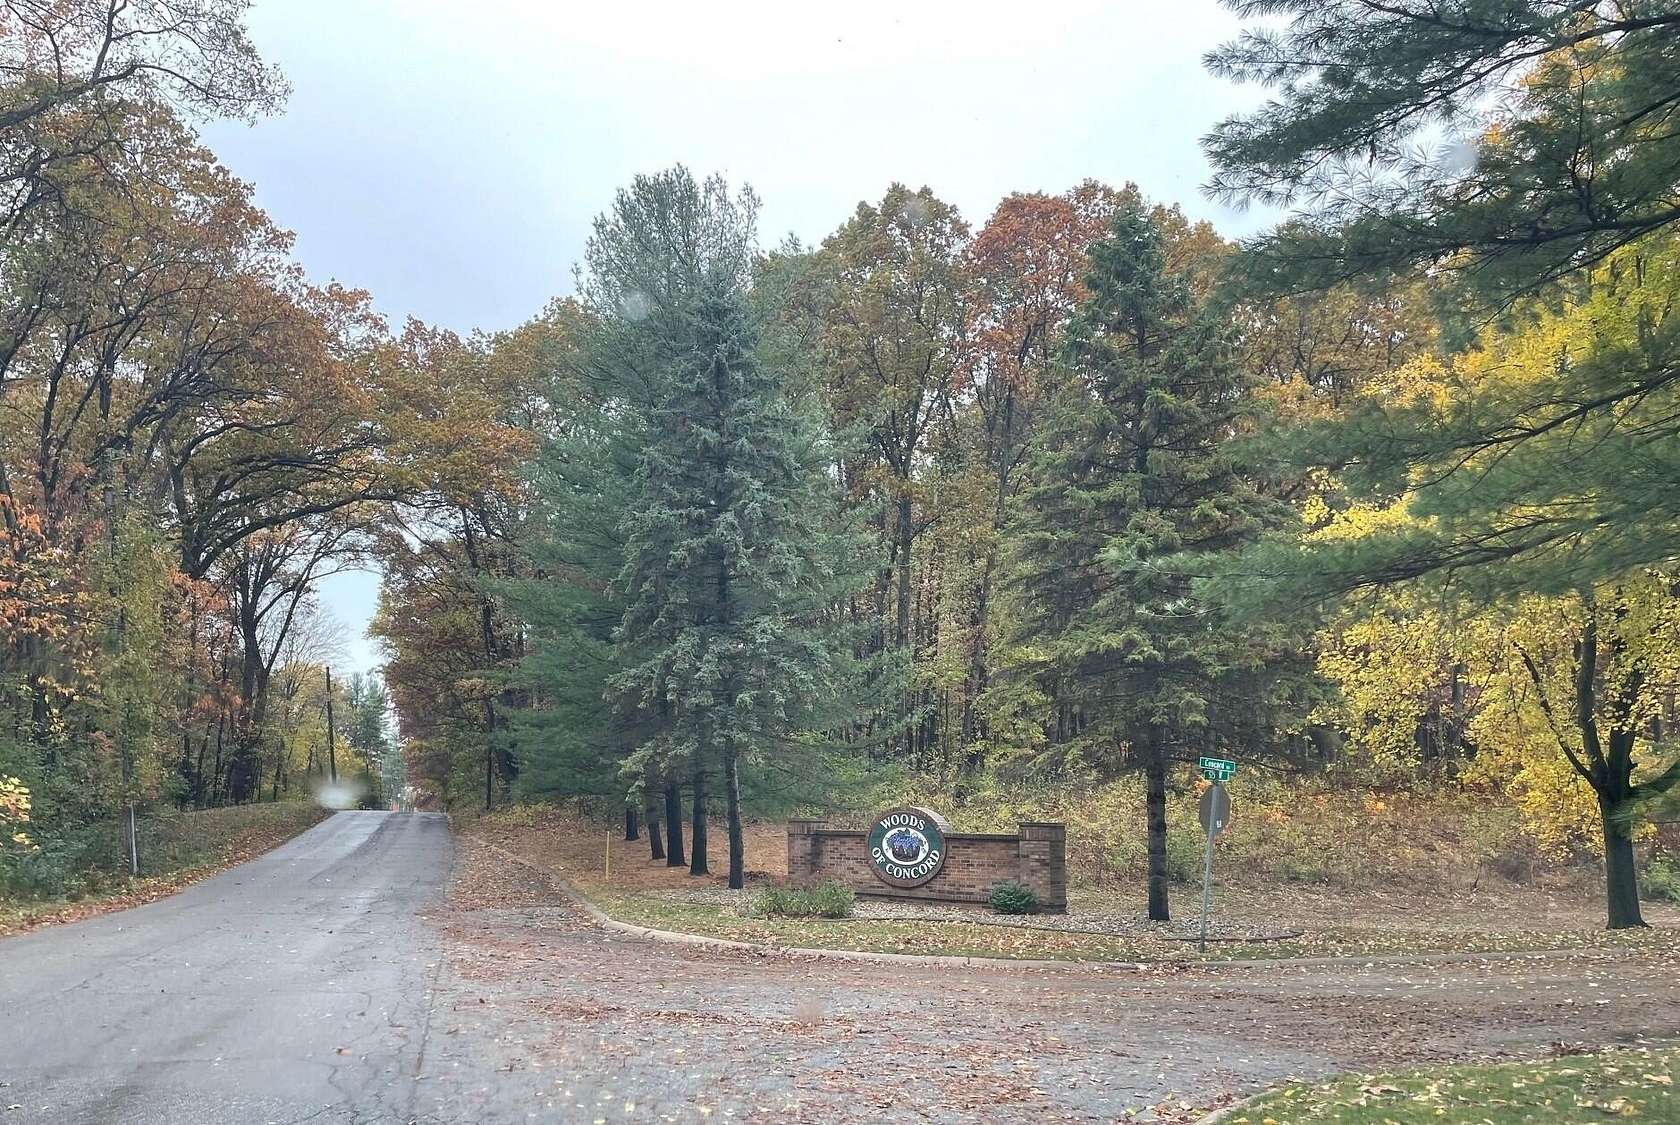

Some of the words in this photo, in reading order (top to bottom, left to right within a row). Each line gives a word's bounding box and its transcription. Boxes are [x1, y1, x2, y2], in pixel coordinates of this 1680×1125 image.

[880, 814, 926, 831] WOODS
[871, 847, 886, 865] OF
[885, 849, 940, 879] CONCORD
